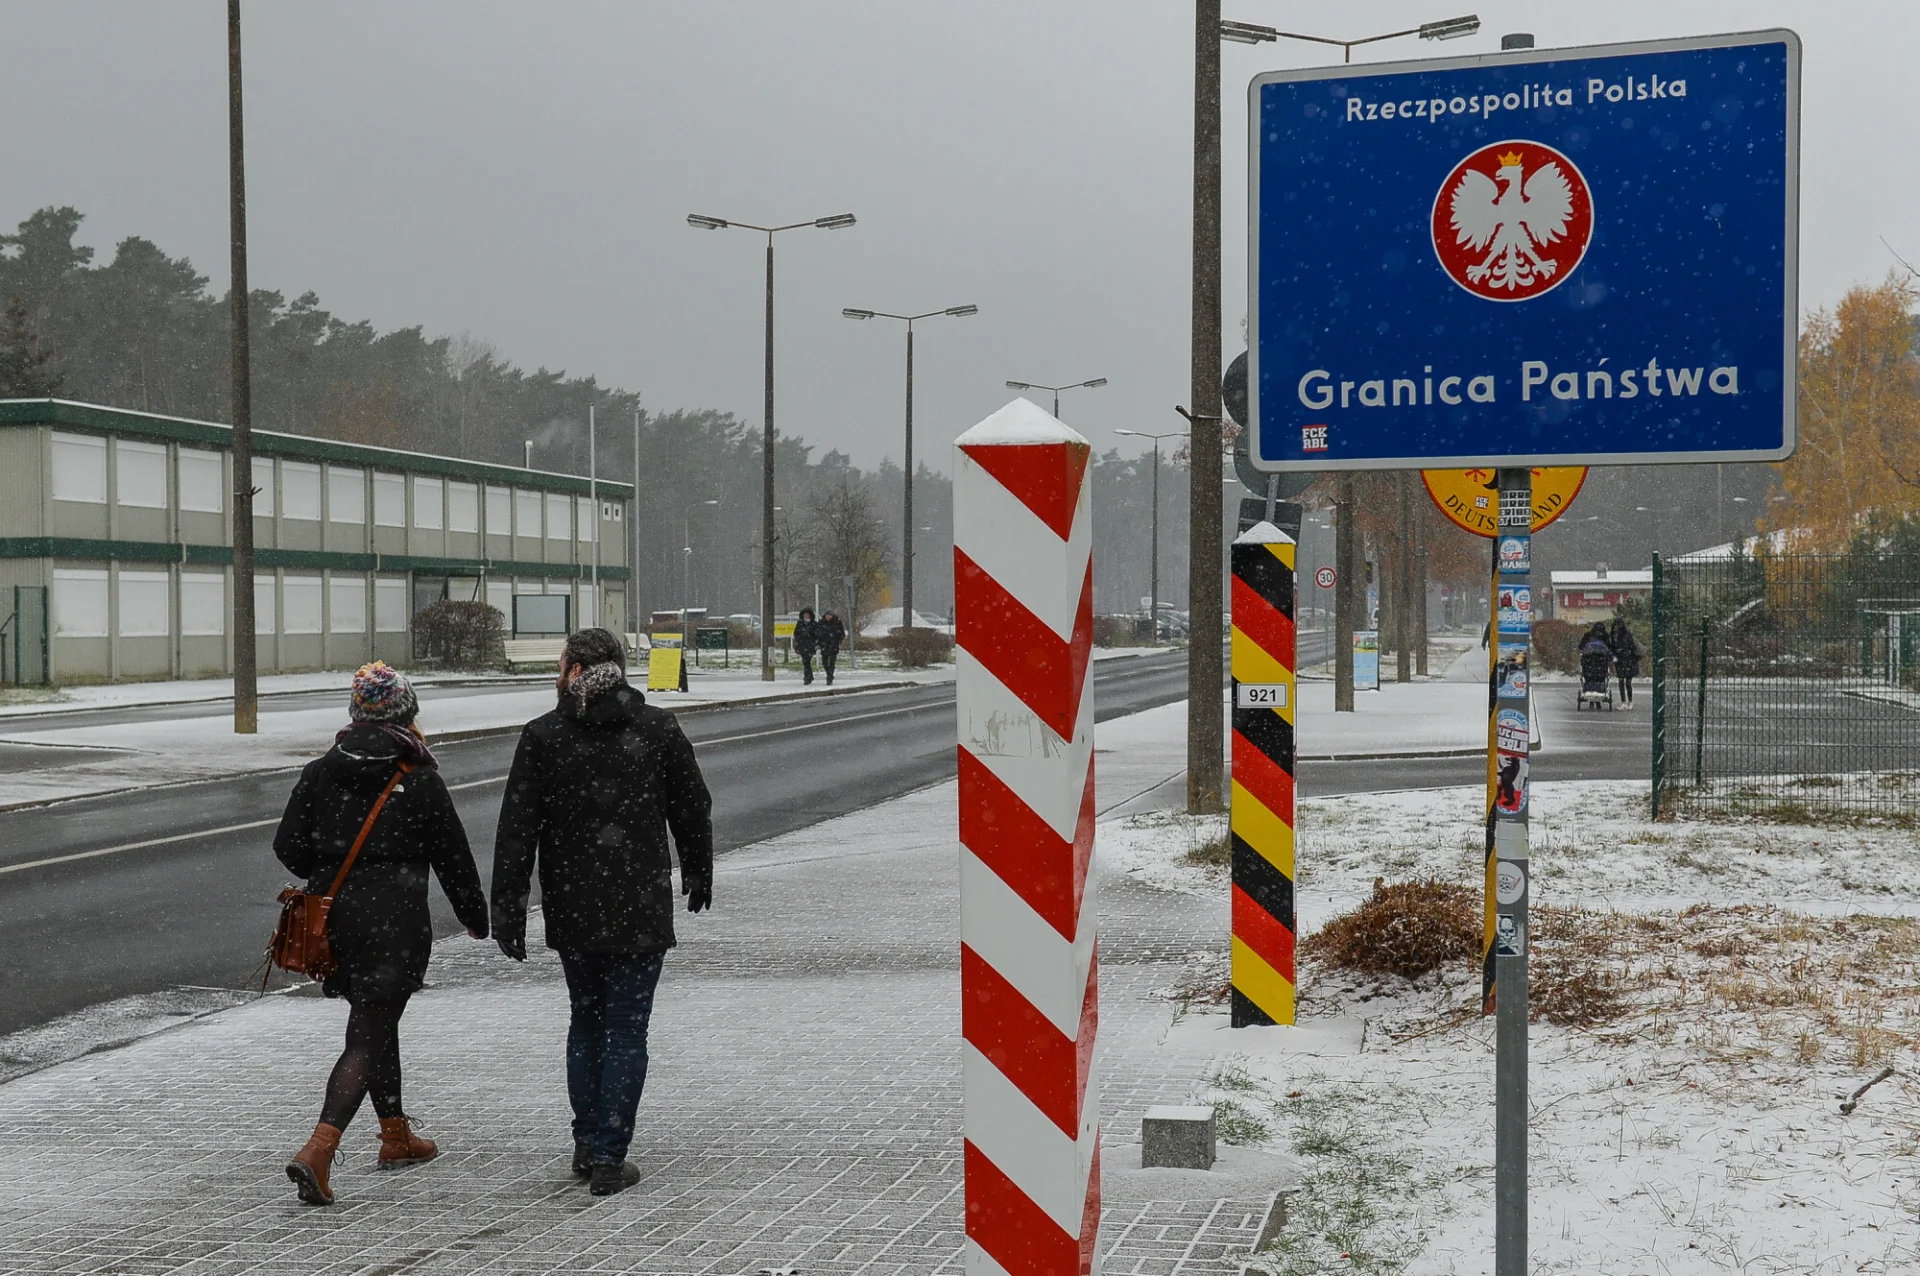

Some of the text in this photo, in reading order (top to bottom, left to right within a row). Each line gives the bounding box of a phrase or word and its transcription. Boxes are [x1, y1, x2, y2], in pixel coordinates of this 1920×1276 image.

[1346, 74, 1687, 123] Rzeczpospolita Polska
[1298, 357, 1738, 410] Granica Państwa
[1302, 427, 1328, 438] FCK
[1303, 438, 1329, 449] RBL
[1444, 493, 1562, 531] DEUTSAND
[1319, 572, 1333, 583] 30
[1249, 688, 1276, 702] 921
